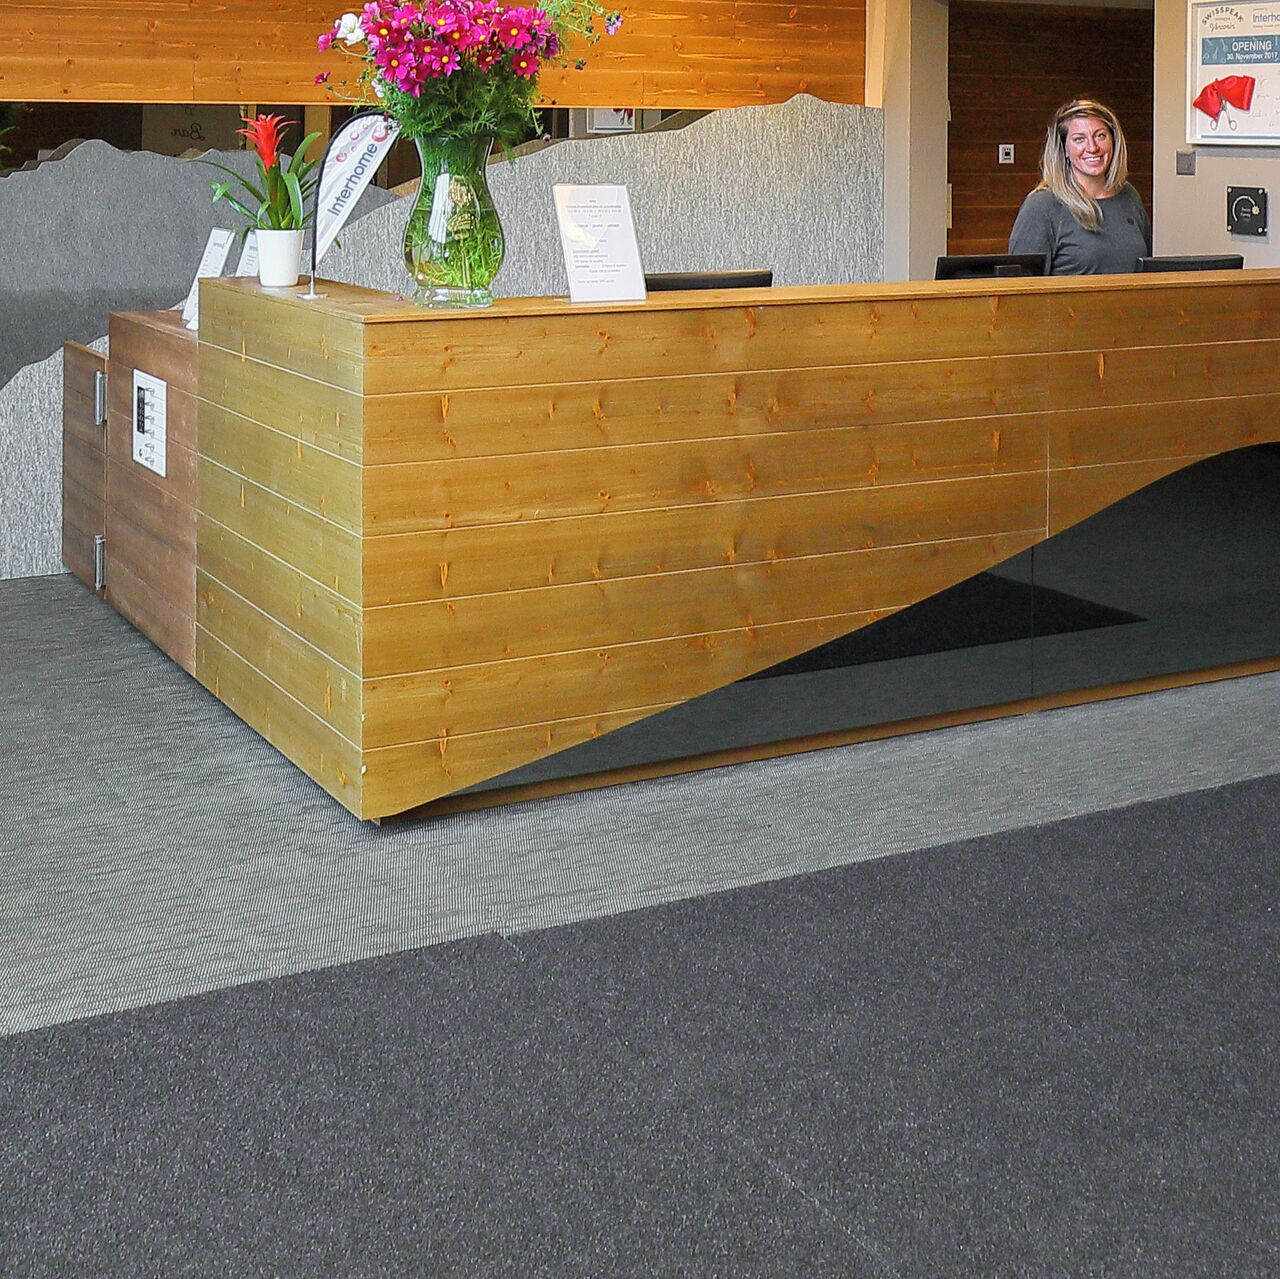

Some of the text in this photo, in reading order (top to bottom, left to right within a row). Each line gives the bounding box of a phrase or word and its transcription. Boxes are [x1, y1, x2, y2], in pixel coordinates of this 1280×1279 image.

[1232, 40, 1272, 51] OPENING
[1235, 51, 1264, 60] November
[1264, 51, 1278, 59] 2017
[327, 143, 378, 217] Interhome
